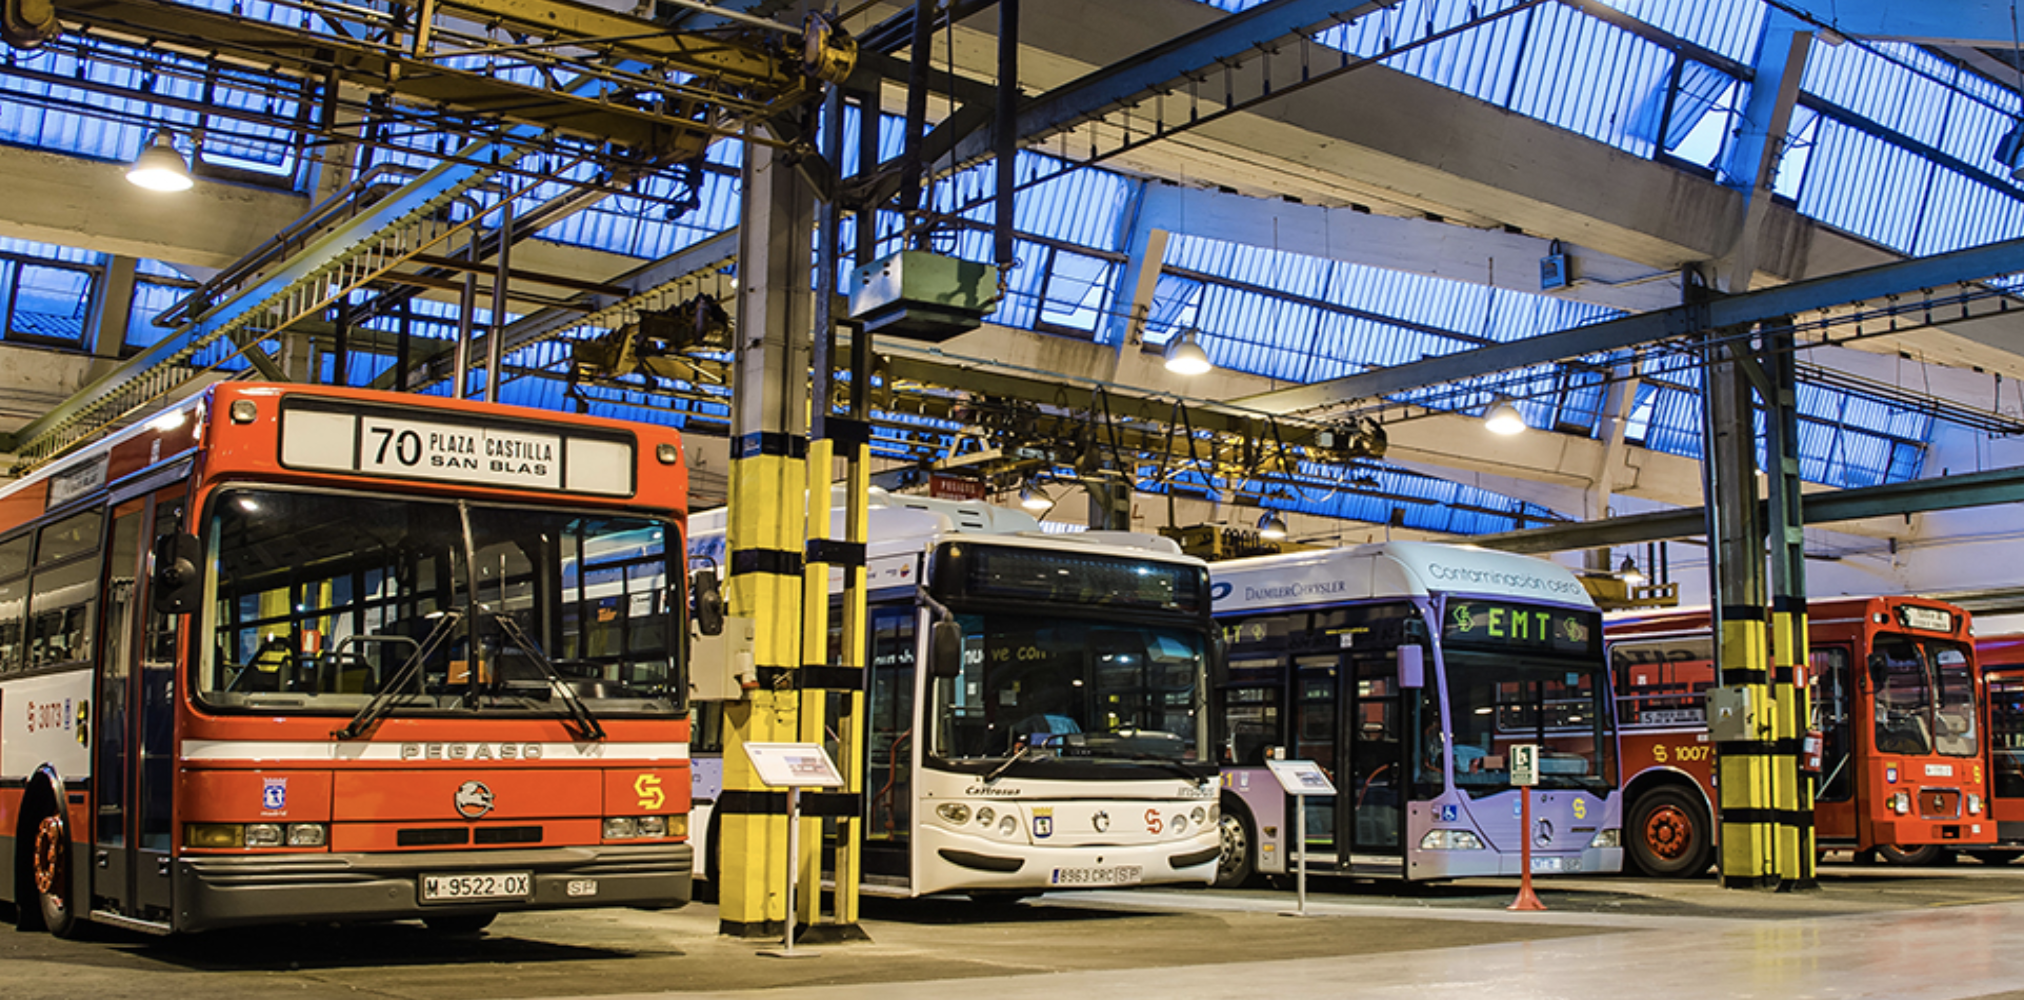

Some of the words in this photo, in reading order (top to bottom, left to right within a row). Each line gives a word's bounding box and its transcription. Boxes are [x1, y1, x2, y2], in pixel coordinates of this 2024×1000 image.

[371, 427, 423, 467] 70
[430, 432, 476, 454] PLAZA
[485, 437, 552, 462] CASTILLA
[430, 455, 479, 470] SAN
[490, 460, 548, 476] BLAS
[401, 742, 543, 760] PEGASO
[1675, 746, 1710, 761] 1007
